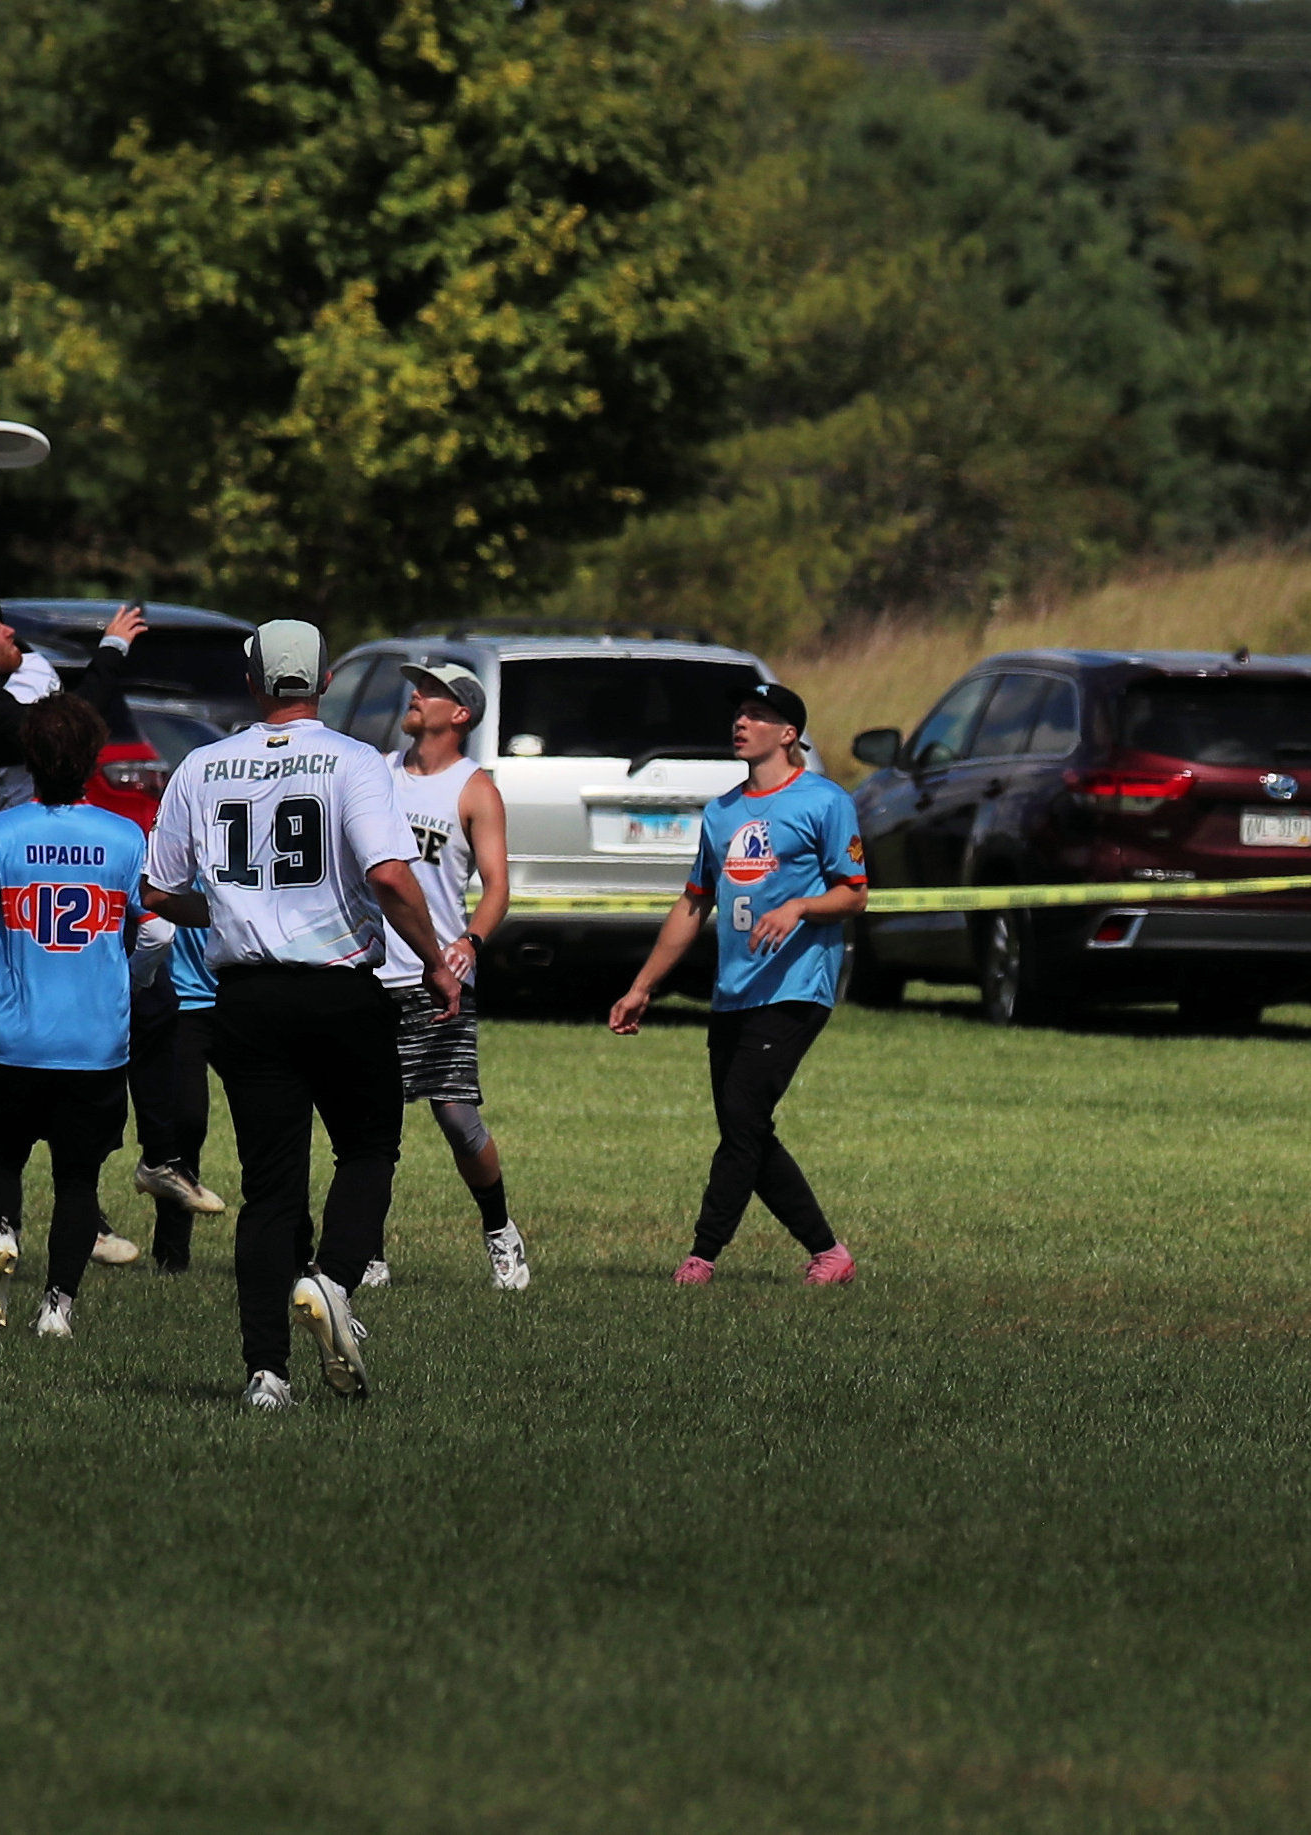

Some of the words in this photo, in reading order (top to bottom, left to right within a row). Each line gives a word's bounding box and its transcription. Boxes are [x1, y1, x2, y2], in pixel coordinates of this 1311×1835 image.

[203, 753, 339, 784] FAUERBACH
[26, 844, 106, 866] DIPAOLO
[212, 793, 326, 891] 19
[36, 884, 92, 946] 12
[733, 896, 752, 931] 6
